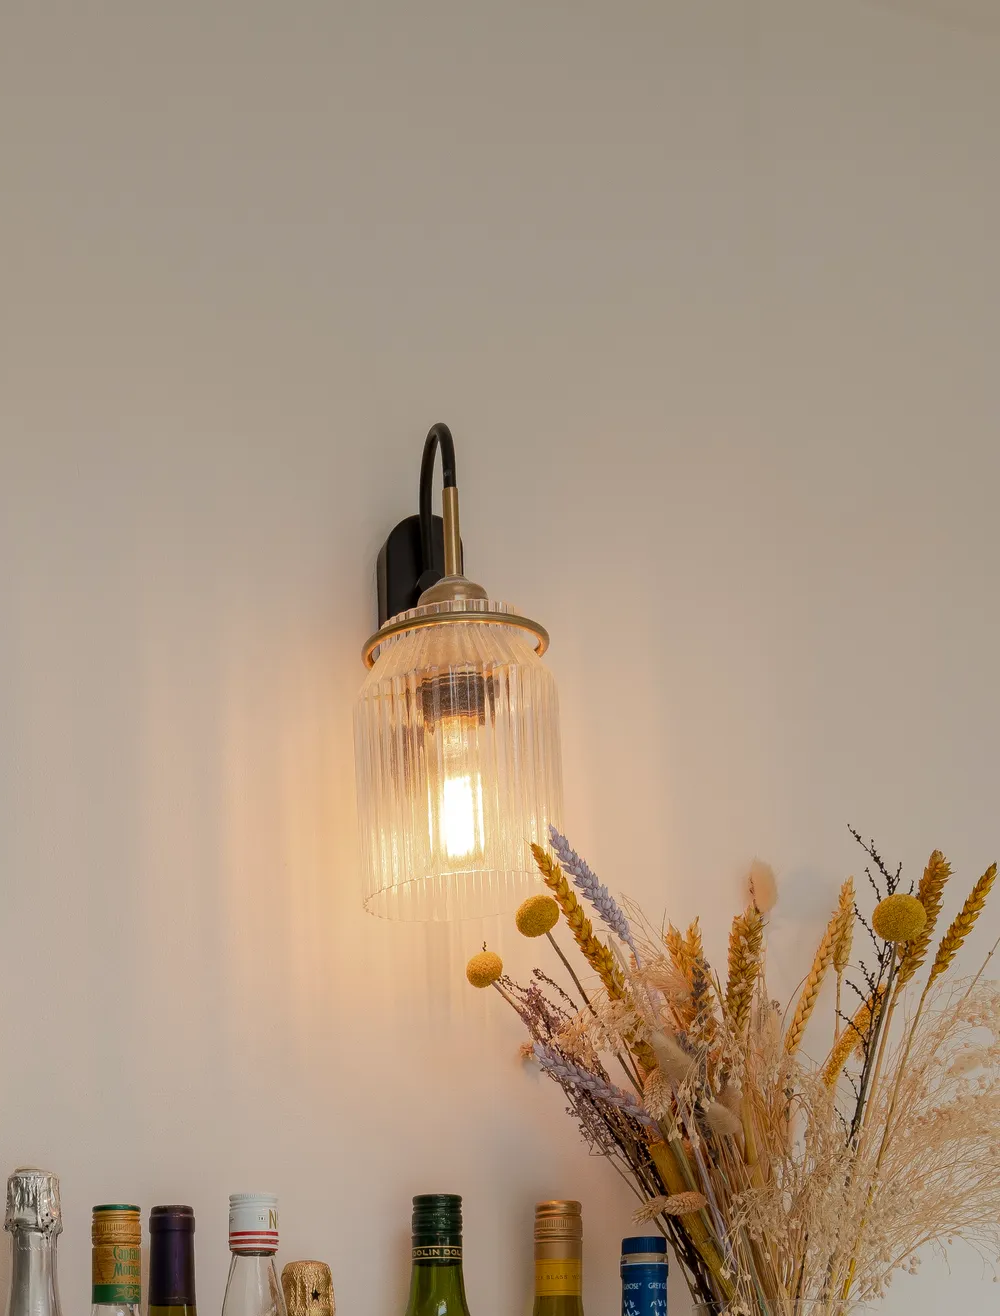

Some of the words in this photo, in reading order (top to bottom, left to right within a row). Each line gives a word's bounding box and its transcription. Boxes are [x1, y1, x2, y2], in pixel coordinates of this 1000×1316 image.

[412, 1248, 440, 1257] DOLIN
[443, 1248, 461, 1256] DOL
[648, 1282, 660, 1290] GREY
